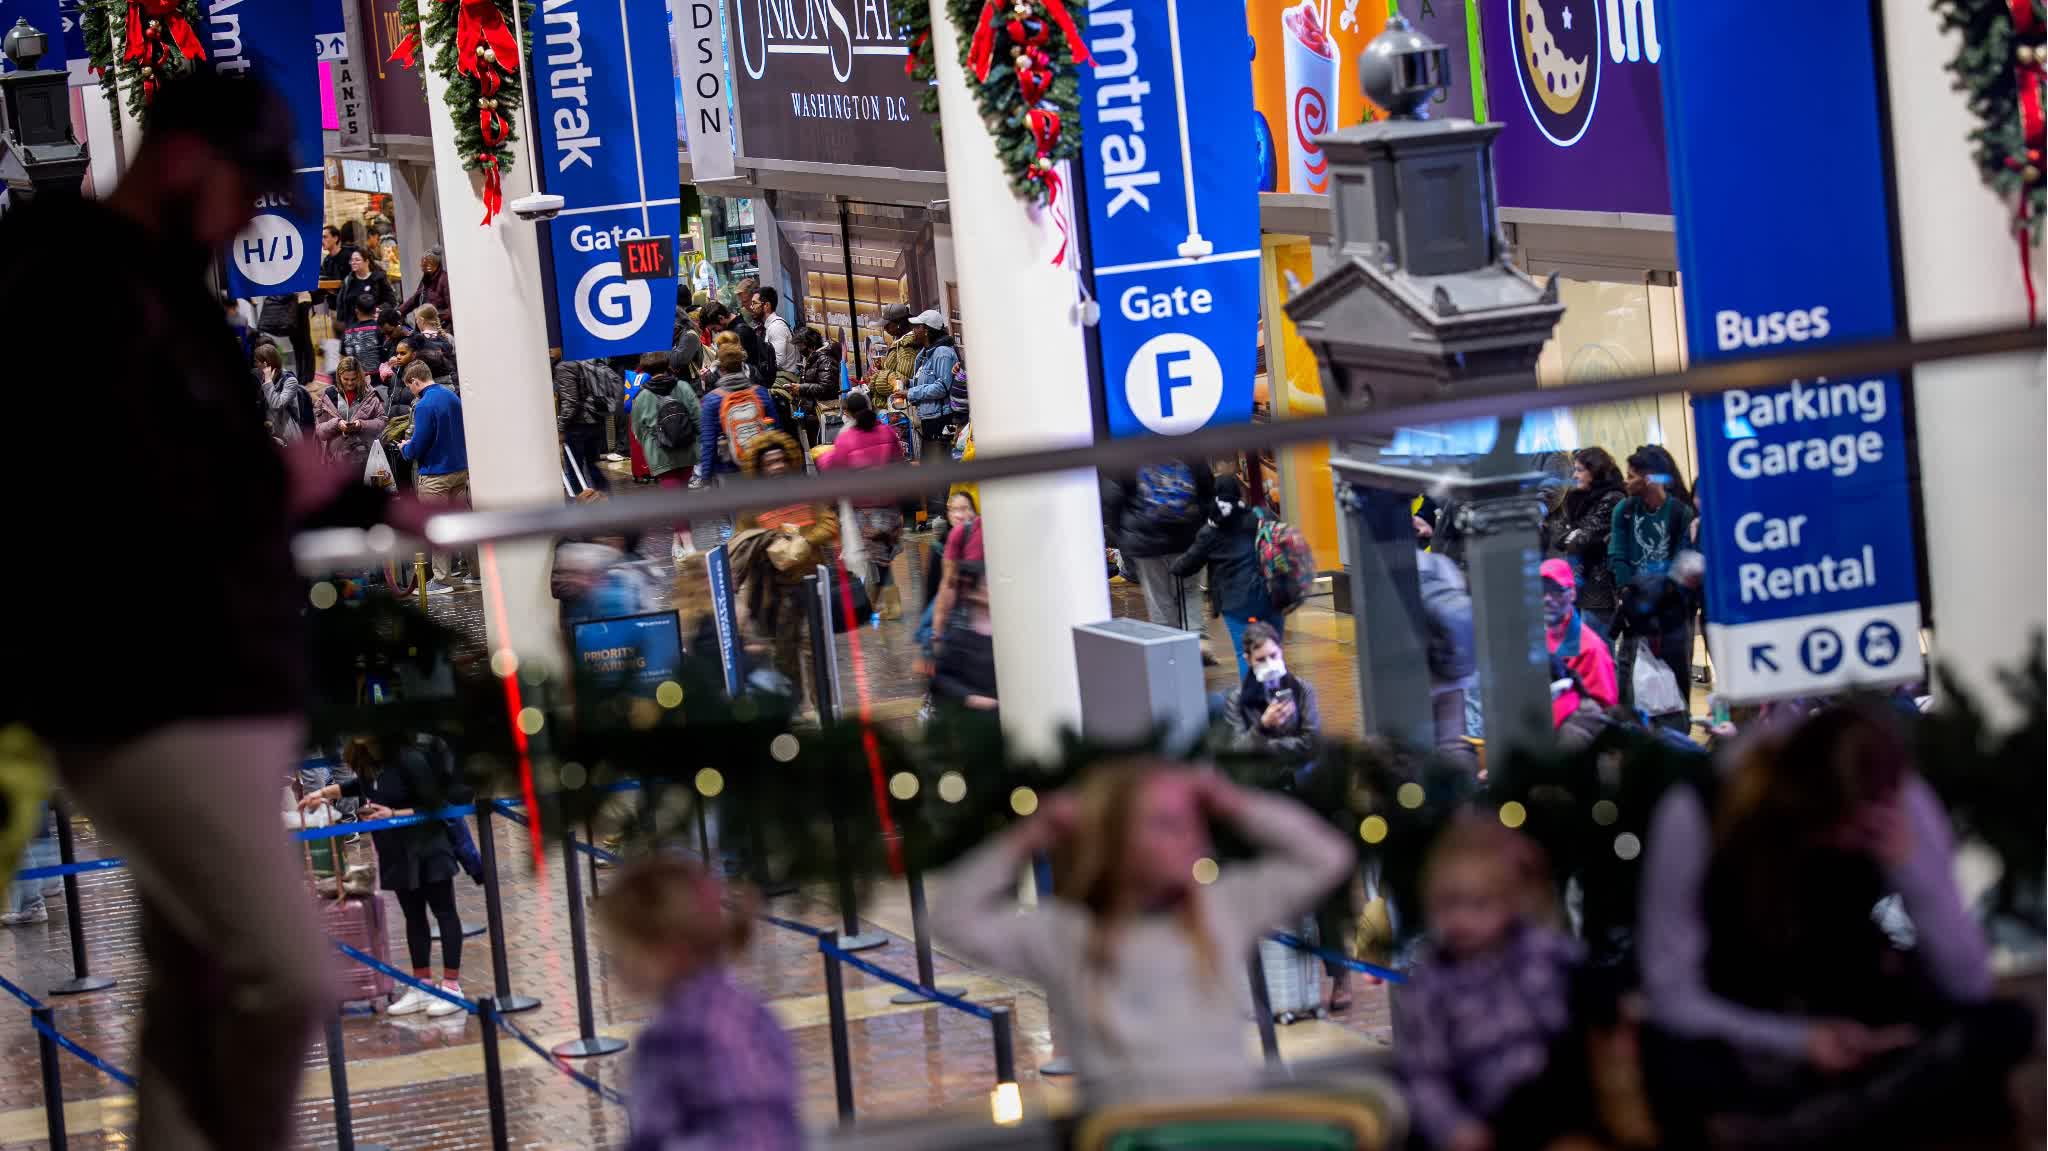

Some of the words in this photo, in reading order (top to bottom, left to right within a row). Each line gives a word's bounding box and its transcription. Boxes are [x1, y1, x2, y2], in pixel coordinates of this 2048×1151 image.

[736, 0, 831, 79] UNION
[691, 4, 721, 133] DSON
[340, 60, 361, 134] ANE'S
[791, 93, 881, 120] WASHINGTON
[886, 96, 910, 121] D.C.
[243, 235, 294, 264] H/J
[627, 242, 661, 273] EXIT
[588, 275, 633, 326] G
[1120, 285, 1213, 321] Gate
[1715, 306, 1831, 351] Buses
[1155, 350, 1192, 418] F
[1723, 376, 1886, 430] Parking
[1727, 430, 1884, 479] Garage
[1734, 511, 1808, 553] Car
[1739, 544, 1876, 604] Rental
